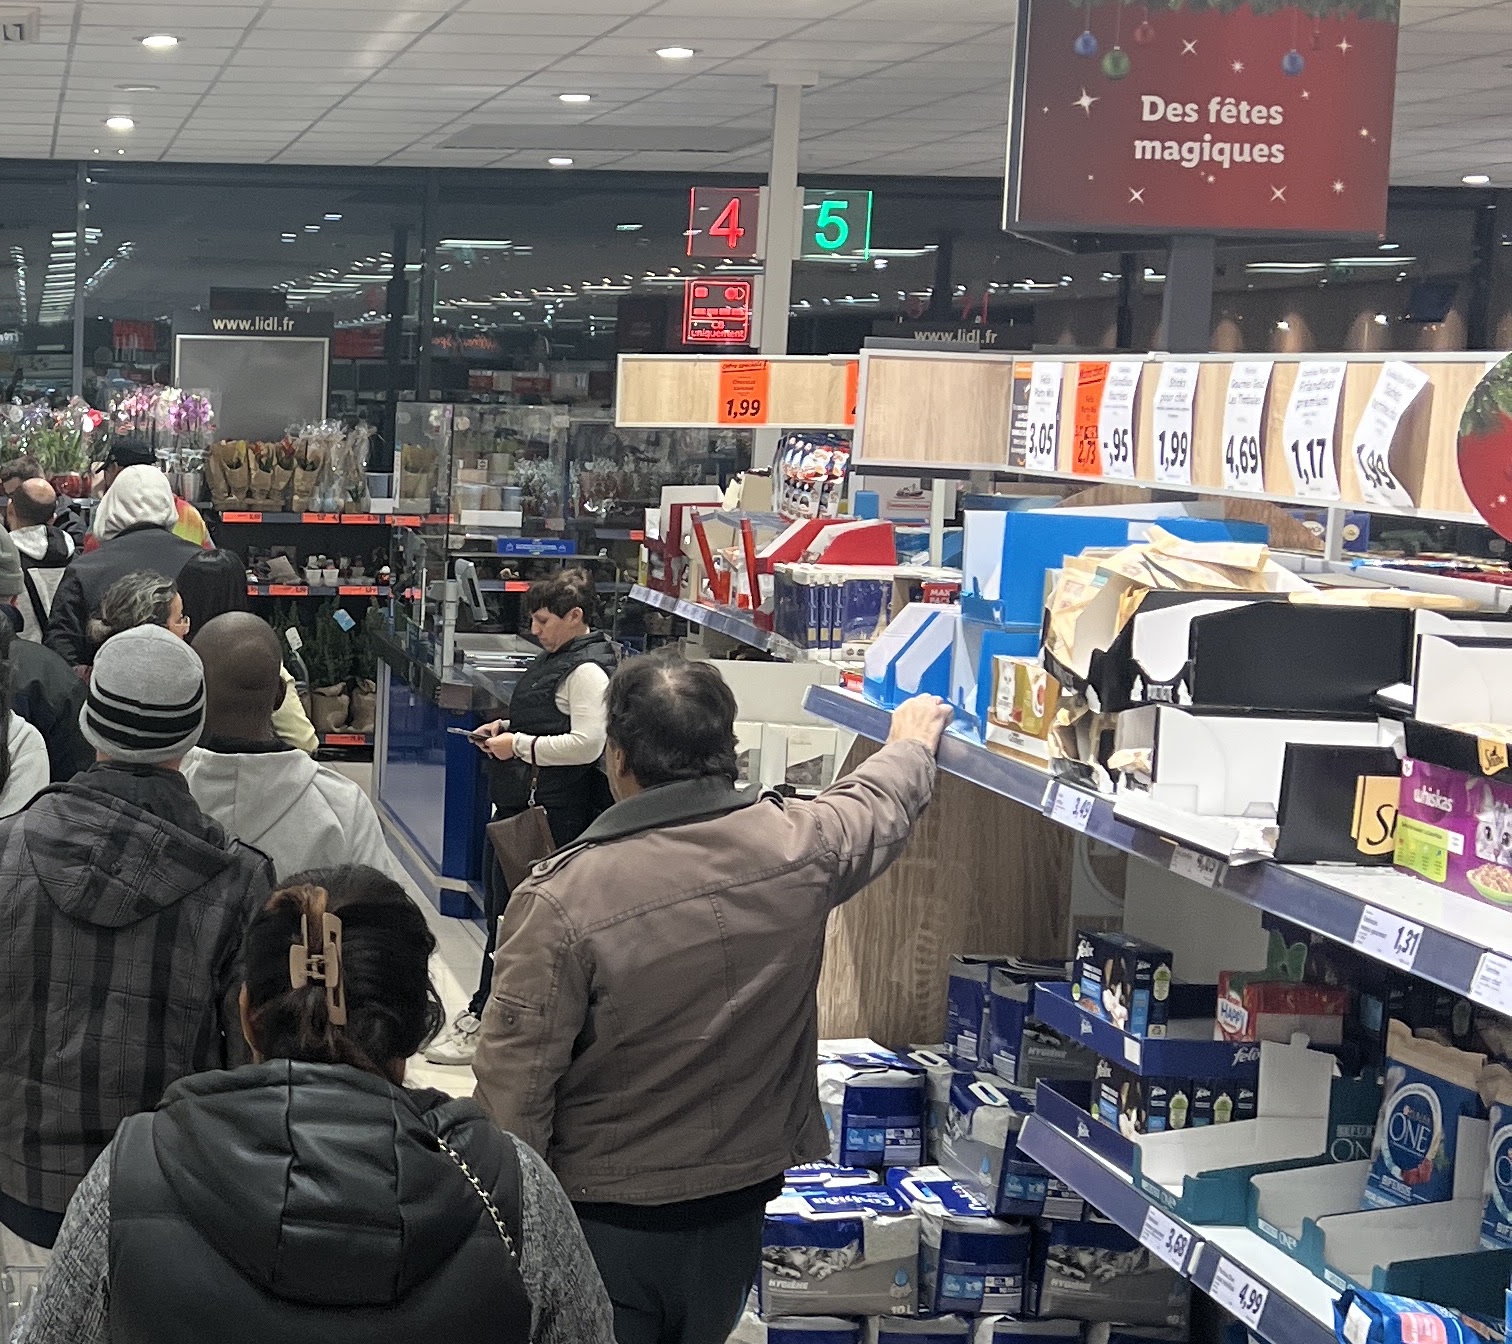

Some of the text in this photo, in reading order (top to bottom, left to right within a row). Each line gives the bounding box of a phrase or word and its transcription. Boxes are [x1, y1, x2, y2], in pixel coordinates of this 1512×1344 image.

[1141, 96, 1284, 127] Des fêtes
[1133, 133, 1285, 168] magiques
[708, 198, 744, 249] 4
[815, 200, 848, 250] 5
[212, 314, 295, 334] www.lidl.fr
[691, 329, 746, 340] uniquement
[914, 326, 998, 346] www.lidl.fr
[726, 399, 760, 418] 1,99
[1029, 423, 1054, 459] 3,05
[1159, 430, 1188, 471] 1,99
[1225, 435, 1258, 479] 4,69
[1291, 438, 1326, 485] 1,17
[1413, 785, 1454, 814] whiskas
[1393, 926, 1420, 957] 1,31
[1389, 1112, 1432, 1153] ONE
[1165, 1228, 1187, 1257] 3,68
[1239, 1284, 1263, 1315] 4,99
